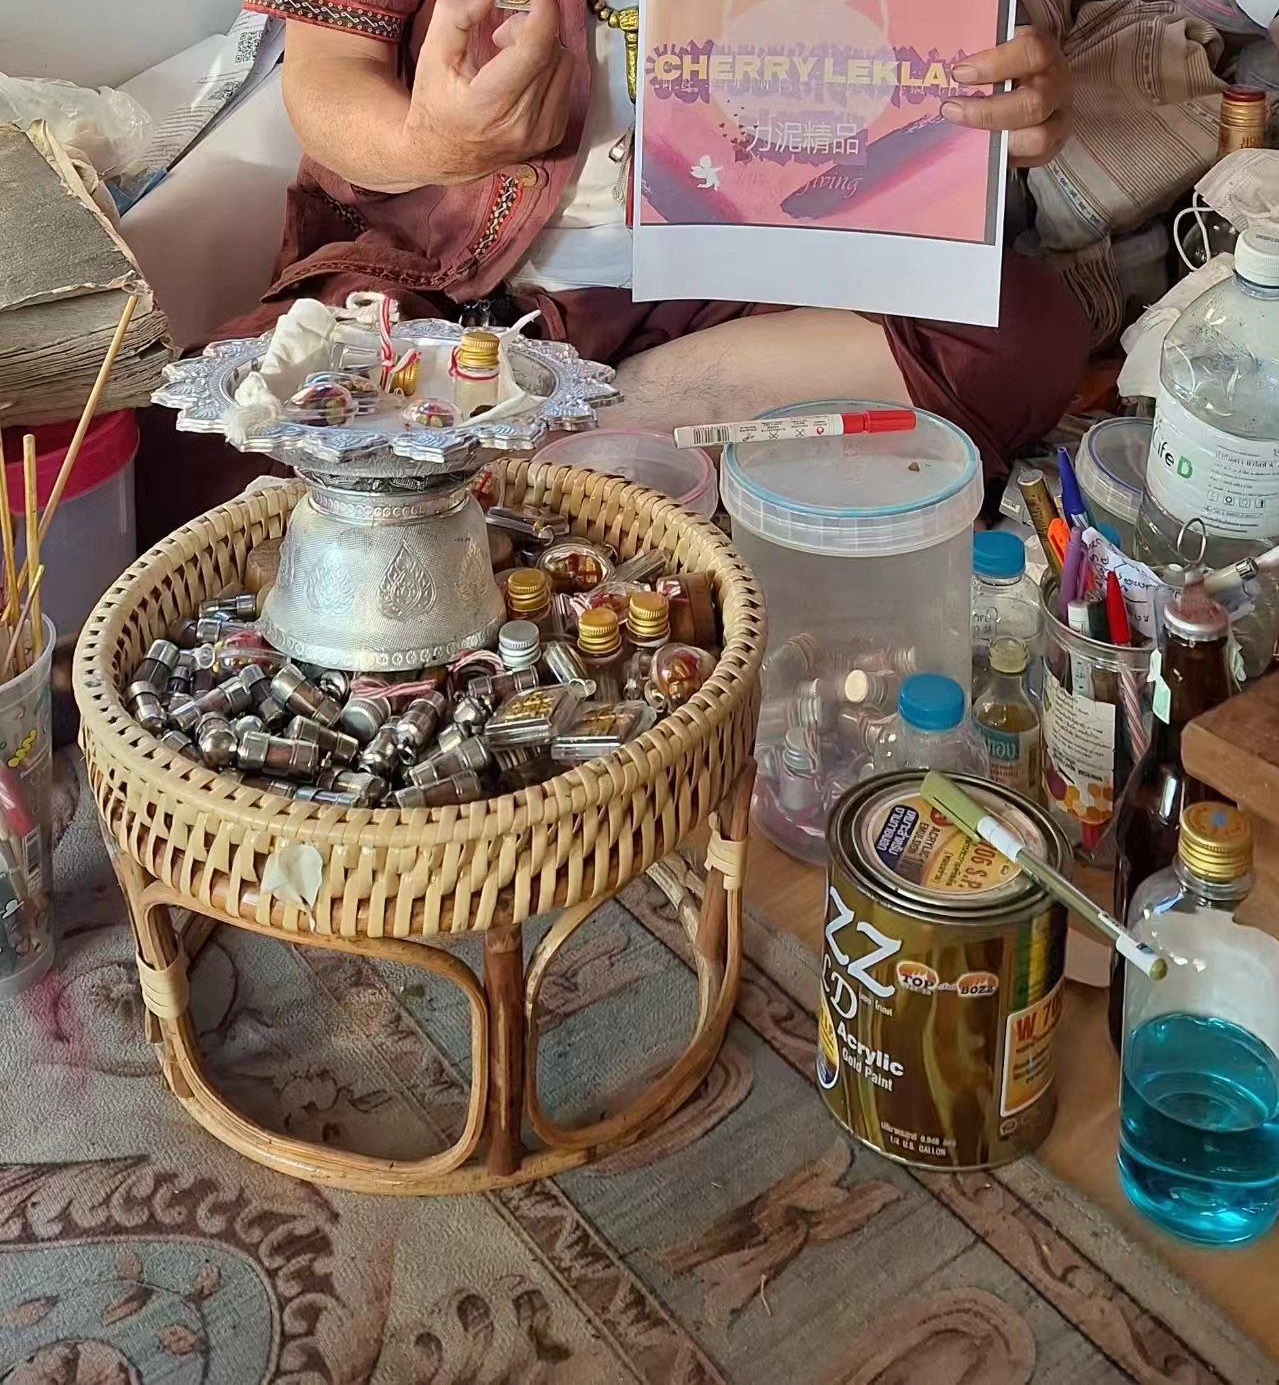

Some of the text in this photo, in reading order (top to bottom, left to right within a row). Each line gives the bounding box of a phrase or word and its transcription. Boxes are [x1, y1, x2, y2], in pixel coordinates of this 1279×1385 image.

[653, 53, 819, 84] CHERRY
[745, 118, 860, 155] 力泥精品
[920, 825, 941, 860] ACRYLIC
[902, 973, 935, 990] TOP
[960, 984, 995, 995] BOZZ
[1015, 1011, 1037, 1042] W
[836, 1019, 905, 1077] Acrylic
[842, 1047, 863, 1074] Gold
[864, 1064, 894, 1092] Paint
[918, 1144, 947, 1157] GALLON
